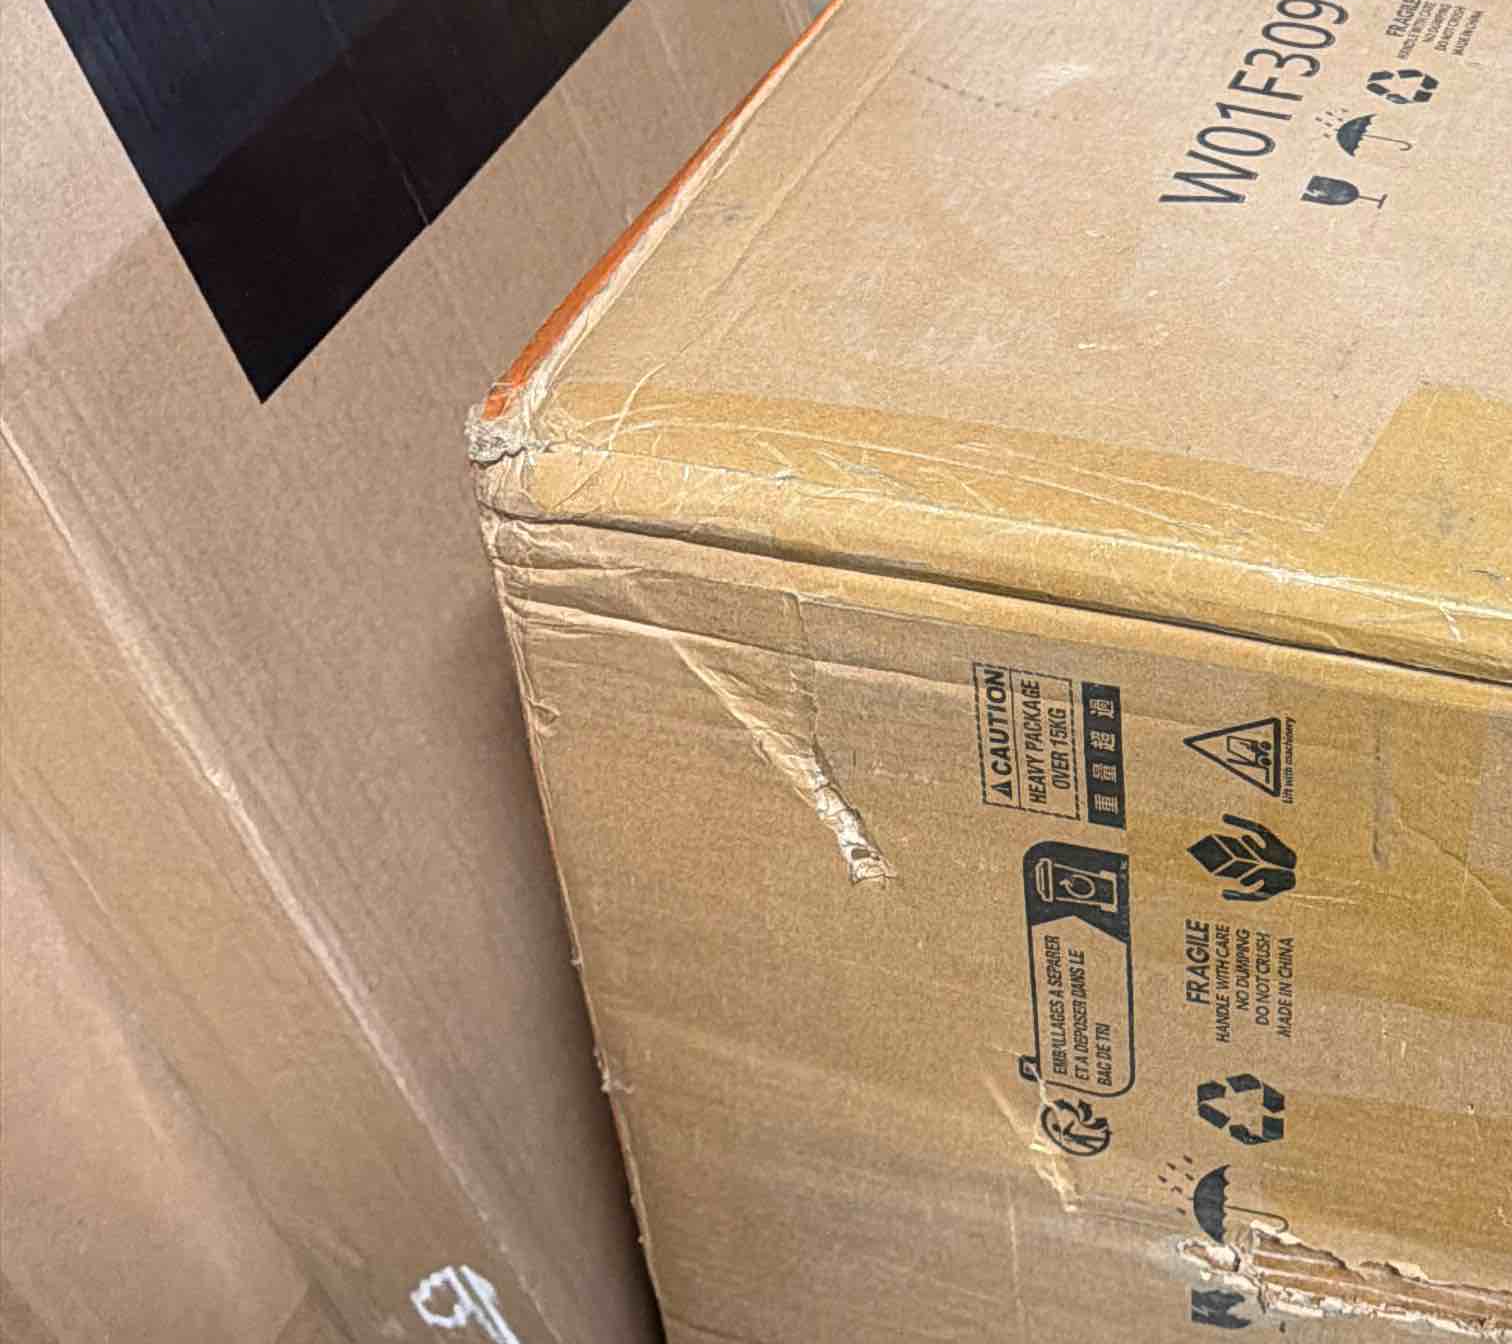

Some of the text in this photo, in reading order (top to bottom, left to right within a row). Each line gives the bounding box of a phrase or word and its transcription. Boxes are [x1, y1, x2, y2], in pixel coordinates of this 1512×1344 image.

[984, 668, 1013, 776] CAUTION
[1021, 678, 1047, 804] HEAVY PACKAGE
[1048, 707, 1072, 790] OVER 15KG
[1068, 947, 1085, 965] LE
[1070, 966, 1087, 999] DANS
[1185, 918, 1211, 1005] FRAGILE
[1215, 923, 1231, 1043] HANDLE WITH CARE
[1235, 928, 1250, 1011] NO DUMPING
[1255, 931, 1272, 1026] DO NOT CRUSH
[1277, 936, 1295, 1038] MADE IN CHINA
[1044, 934, 1068, 1076] EMBALLAGES A SEPARER
[1072, 1000, 1089, 1054] DEPOSER
[1095, 1022, 1111, 1042] TRI
[1074, 1064, 1089, 1081] ET
[1096, 1044, 1112, 1063] DE
